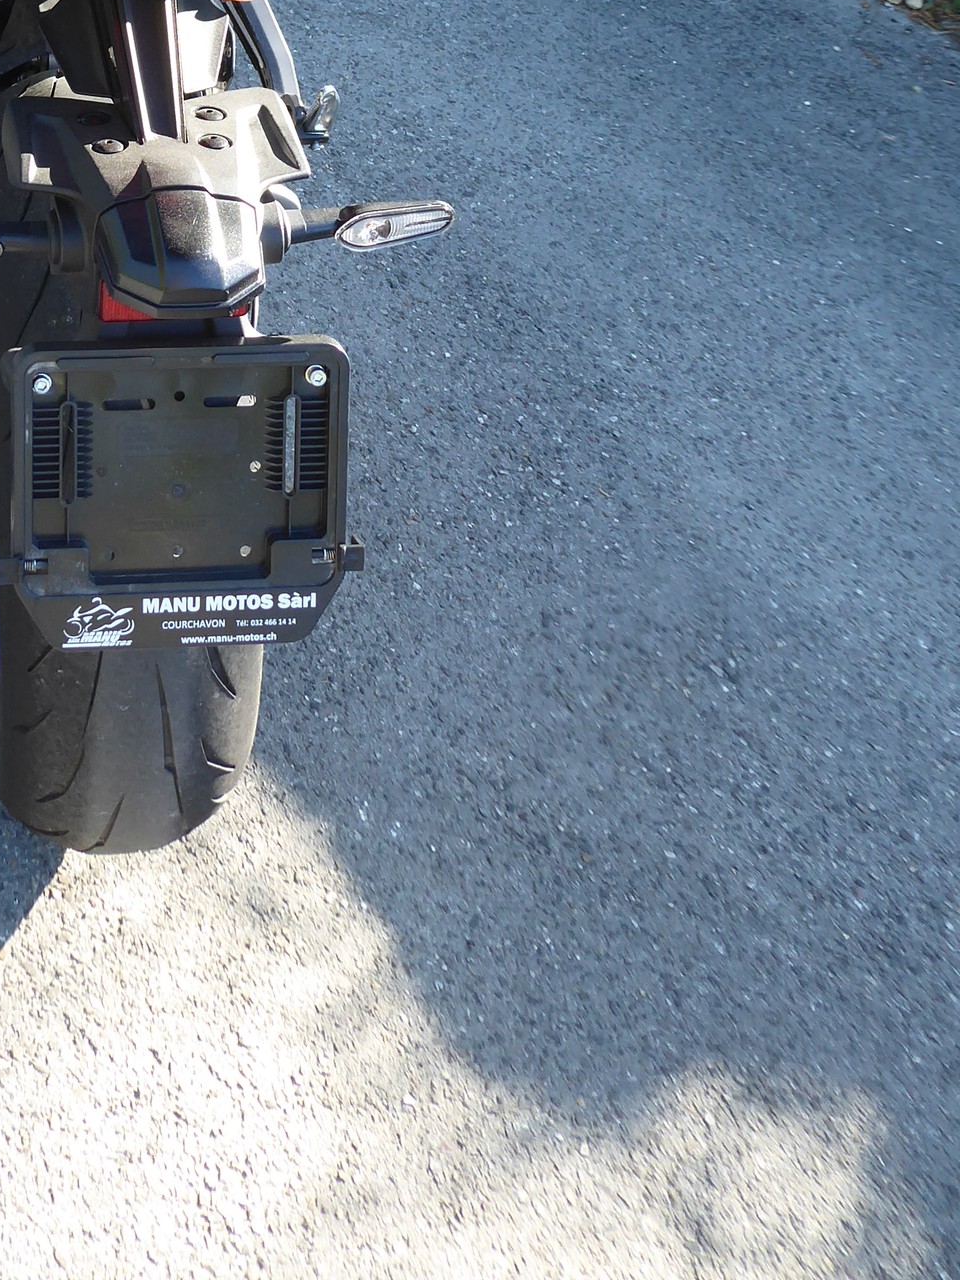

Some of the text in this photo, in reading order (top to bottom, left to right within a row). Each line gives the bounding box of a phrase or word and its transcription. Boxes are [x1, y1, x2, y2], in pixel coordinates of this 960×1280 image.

[142, 591, 317, 614] MANU MOTOS Sàrl
[161, 619, 226, 630] COURCHAVON
[250, 619, 263, 627] 032
[263, 618, 277, 626] 466
[278, 618, 287, 626] 14
[287, 617, 297, 625] 14
[81, 631, 121, 643] MANU
[180, 631, 278, 644] www.manu-motos.ch
